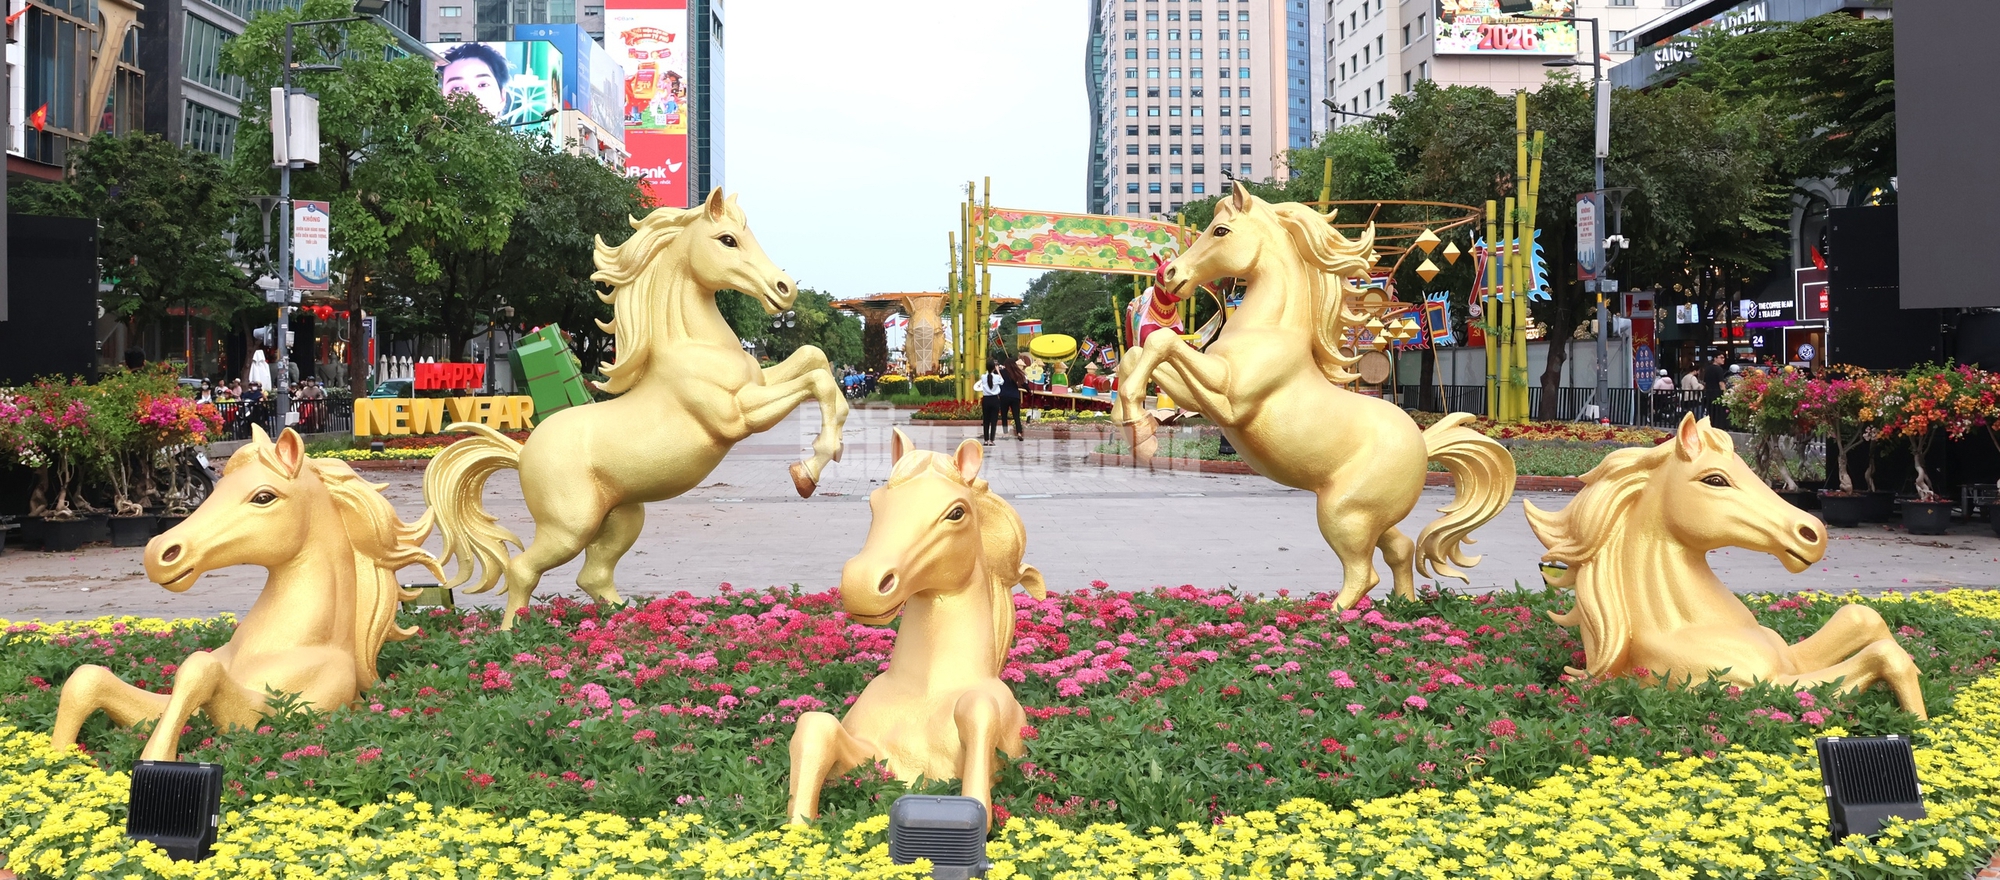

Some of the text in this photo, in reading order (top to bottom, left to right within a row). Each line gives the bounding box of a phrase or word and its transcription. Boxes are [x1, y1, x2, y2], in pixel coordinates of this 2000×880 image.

[1477, 24, 1539, 50] 2026
[1753, 336, 1763, 344] 24
[415, 363, 486, 389] HAPPY
[354, 395, 535, 436] NEW YEAR
